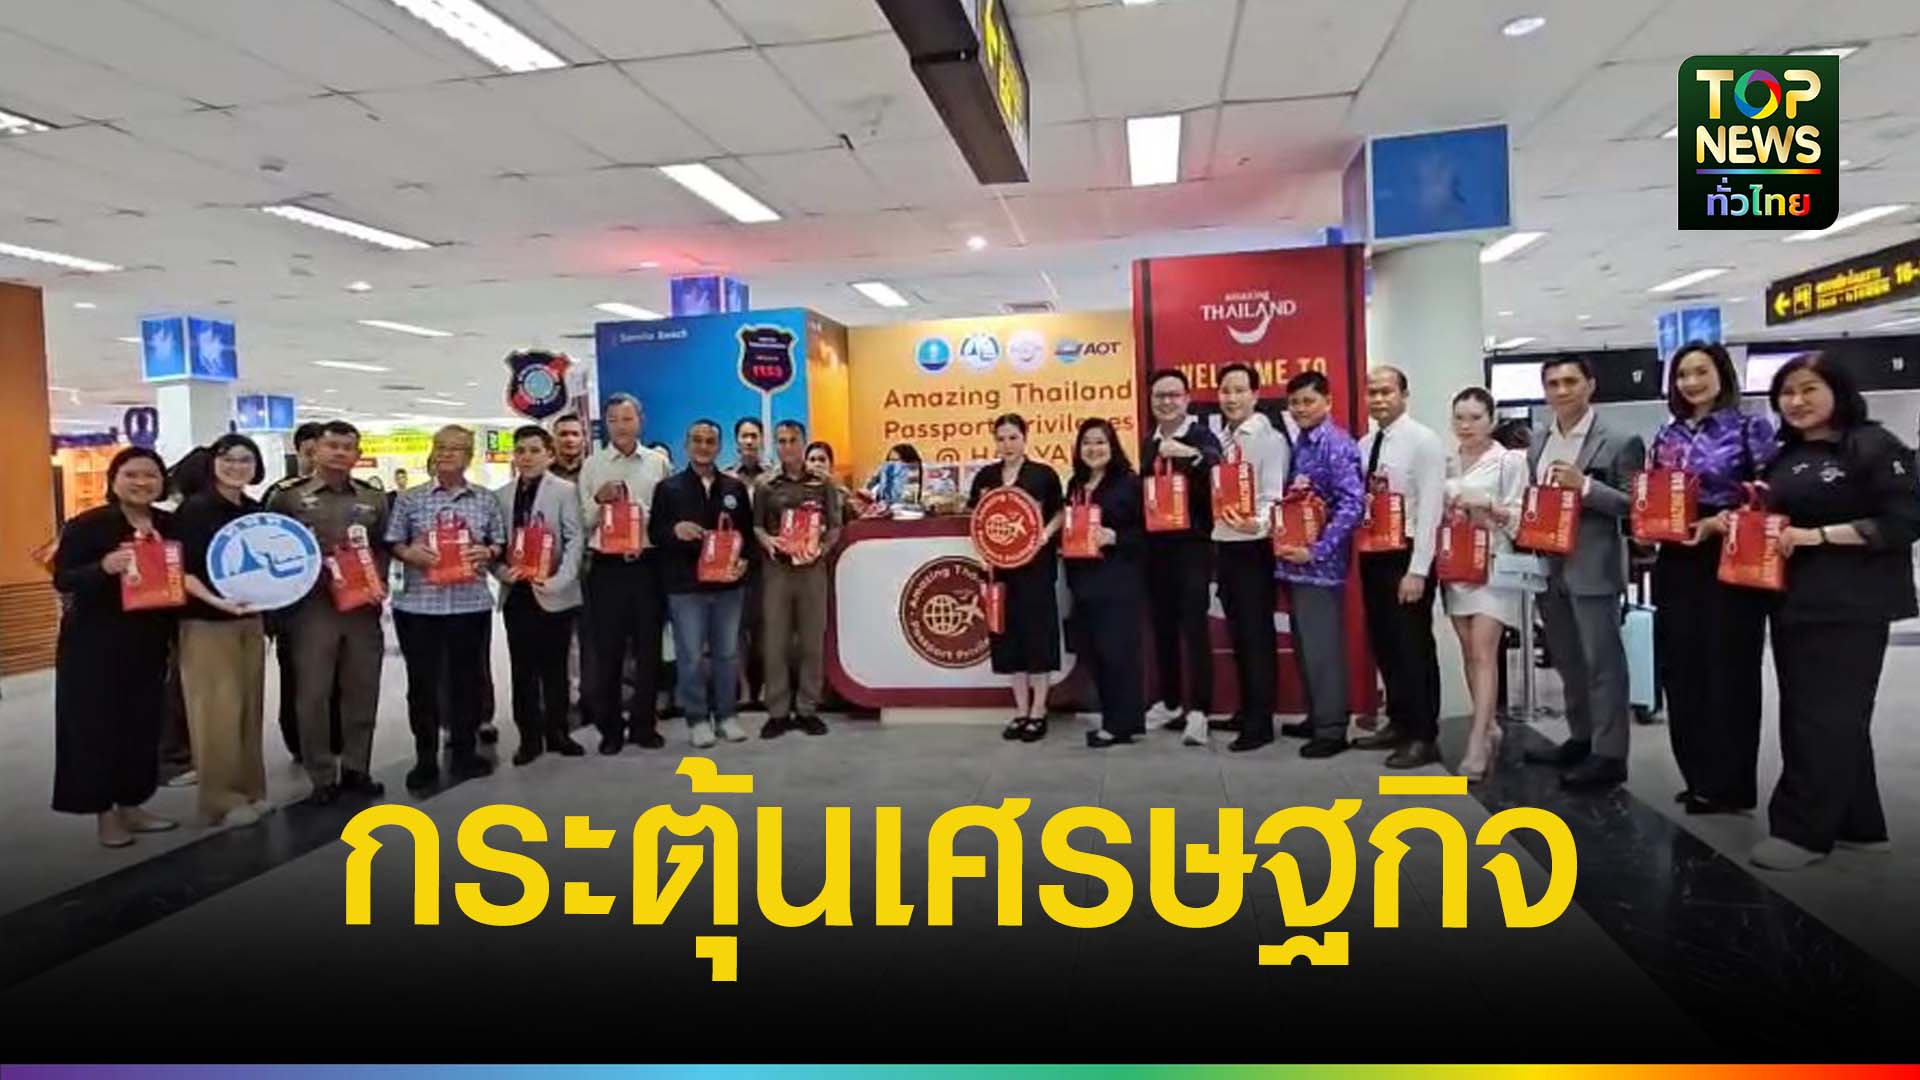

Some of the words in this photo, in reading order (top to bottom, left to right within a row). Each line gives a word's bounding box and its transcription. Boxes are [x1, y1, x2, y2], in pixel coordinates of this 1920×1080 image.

[1200, 300, 1297, 321] THAILAND
[1083, 341, 1121, 356] AOT
[1174, 359, 1289, 389] WELME
[884, 386, 1000, 409] Amazing
[1011, 380, 1132, 402] Thailand
[884, 420, 996, 442] Passport
